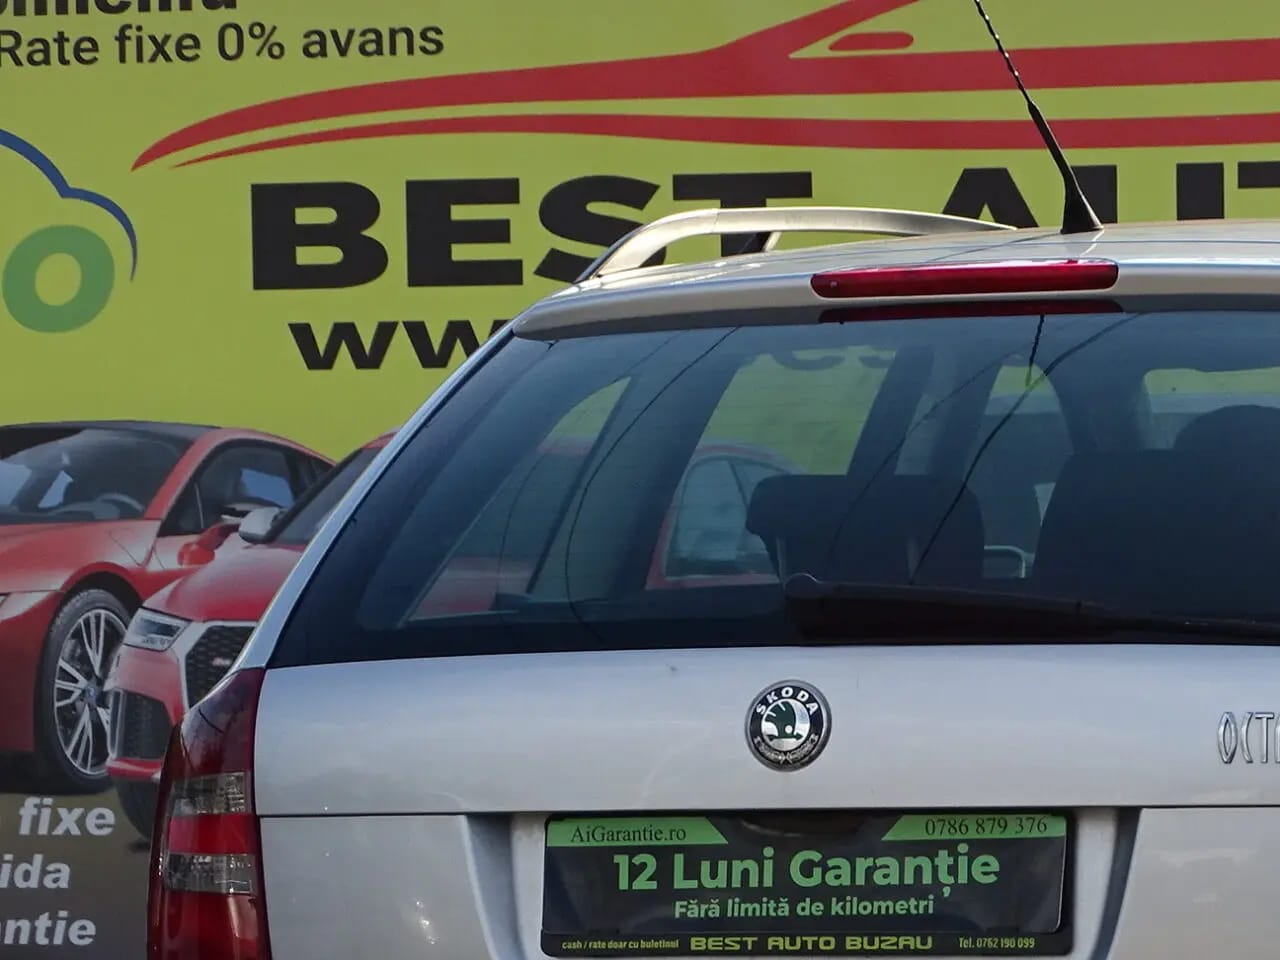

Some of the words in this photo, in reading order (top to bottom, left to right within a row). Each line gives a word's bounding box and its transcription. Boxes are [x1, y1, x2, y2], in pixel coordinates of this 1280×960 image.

[0, 29, 99, 68] Rate
[114, 24, 200, 65] fixe
[217, 21, 286, 61] 0%
[302, 25, 444, 58] avans
[250, 171, 813, 291] BEST
[18, 797, 116, 836] fixe
[925, 818, 969, 836] 0786
[975, 817, 1008, 835] 879
[1015, 816, 1048, 834] 376
[570, 824, 687, 843] AiGarantie.ro
[613, 854, 658, 890] 12
[673, 846, 775, 889] Luni
[789, 843, 1000, 897] Garanție
[674, 898, 720, 919] Fără
[727, 897, 790, 918] limită
[796, 897, 825, 916] de
[831, 895, 934, 915] kilometri
[0, 911, 97, 946] ntie
[561, 939, 582, 950] cash
[588, 938, 606, 949] rate
[690, 937, 758, 951] BEST
[767, 936, 836, 951] AUTO
[845, 936, 934, 951] BUZAU
